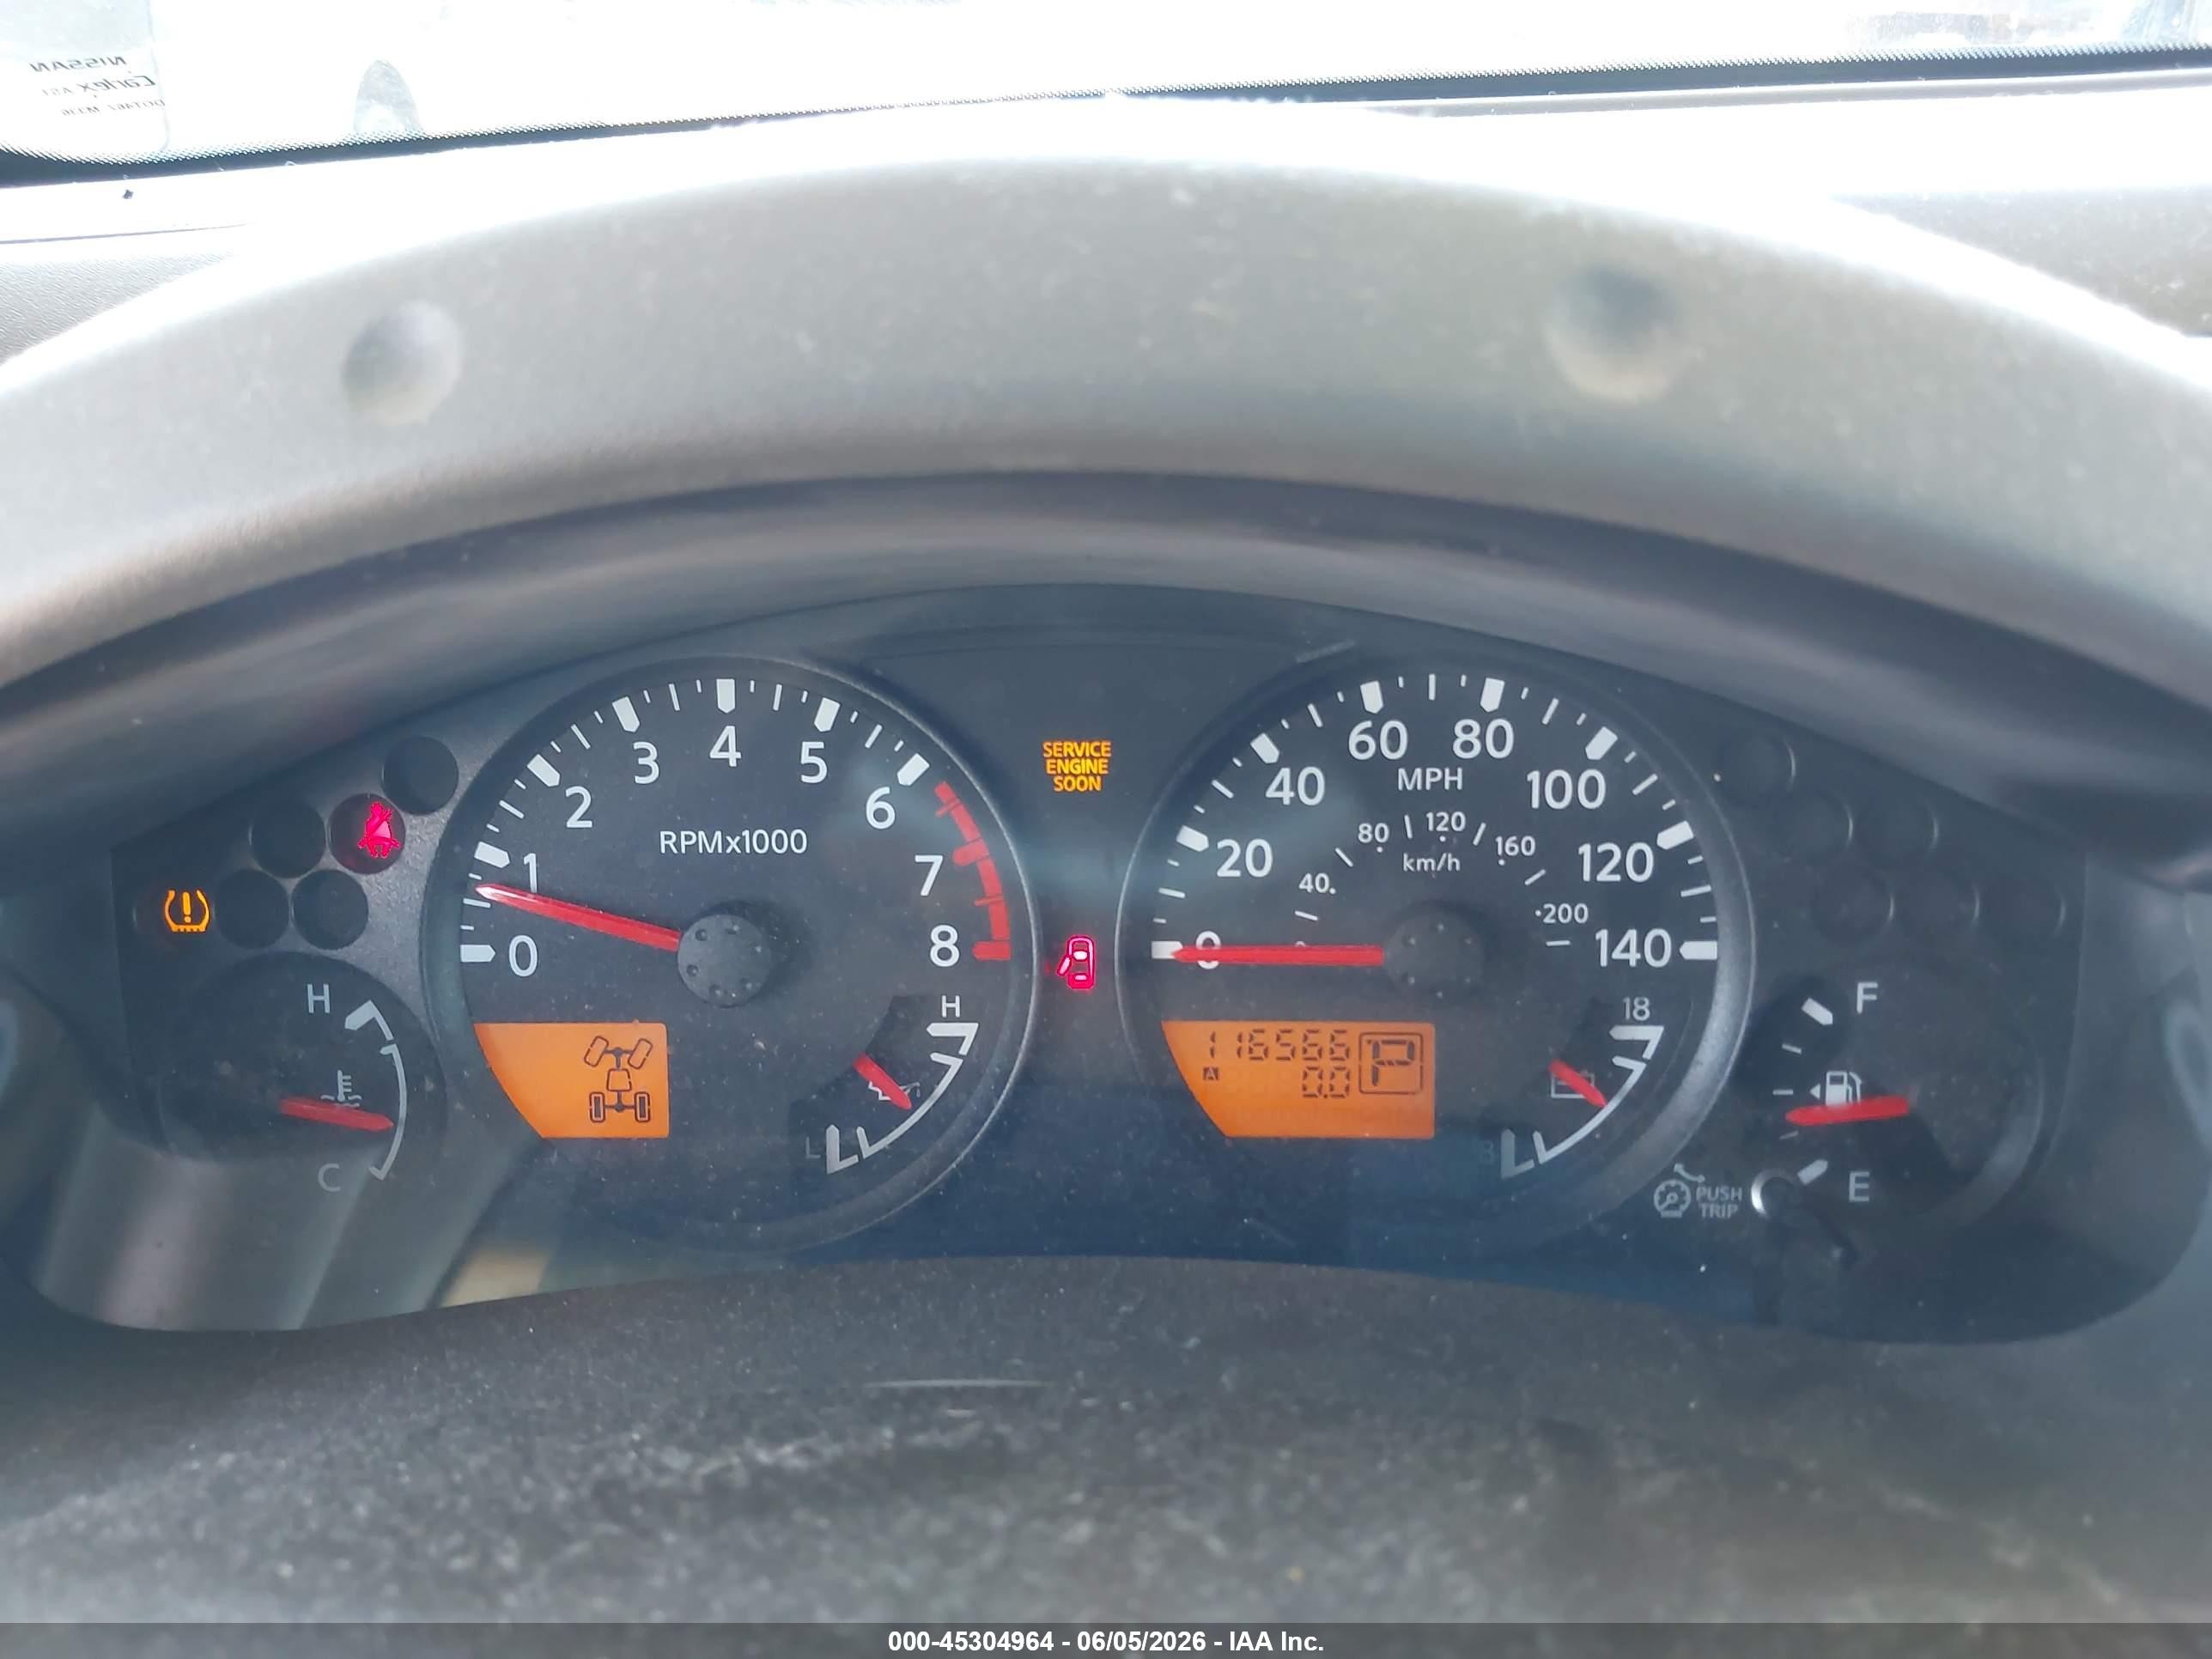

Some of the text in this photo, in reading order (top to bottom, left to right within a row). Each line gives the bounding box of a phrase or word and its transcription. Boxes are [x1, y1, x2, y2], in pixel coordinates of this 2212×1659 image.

[710, 726, 741, 766] 4
[1043, 742, 1110, 757] SERVICE
[1349, 720, 1407, 759] 60
[1453, 719, 1513, 758] 80
[634, 742, 659, 783] 3
[801, 742, 827, 783] 5
[1047, 758, 1108, 774] ENGINE
[1054, 775, 1101, 791] SOON
[1266, 767, 1324, 805] 40
[1399, 768, 1462, 790] MPH
[1528, 769, 1605, 809] 100
[566, 787, 592, 828] 2
[866, 787, 895, 829] 6
[1427, 811, 1465, 831] 120
[660, 830, 806, 853] RPMx1000
[1358, 823, 1389, 842] 80
[1496, 836, 1535, 855] 160
[1218, 839, 1273, 877] 20
[1404, 854, 1460, 871] km/h
[1579, 842, 1653, 882] 120
[524, 854, 538, 894] 1
[915, 855, 943, 896] 7
[1544, 903, 1588, 923] 200
[509, 935, 537, 976] 0
[931, 926, 959, 966] 8
[1596, 929, 1671, 967] 140
[307, 984, 330, 1012] H
[942, 995, 960, 1017] H
[1623, 997, 1650, 1020] 18
[1857, 982, 1877, 1013] F
[1210, 1029, 1350, 1061] 116566
[1204, 1067, 1218, 1080] A
[1372, 1040, 1415, 1086] P
[1302, 1066, 1350, 1098] 0.0
[805, 1136, 821, 1159] L
[319, 1164, 341, 1192] C
[1696, 1187, 1741, 1200] PUSH
[1850, 1172, 1869, 1201] E
[1699, 1203, 1738, 1218] TRIP
